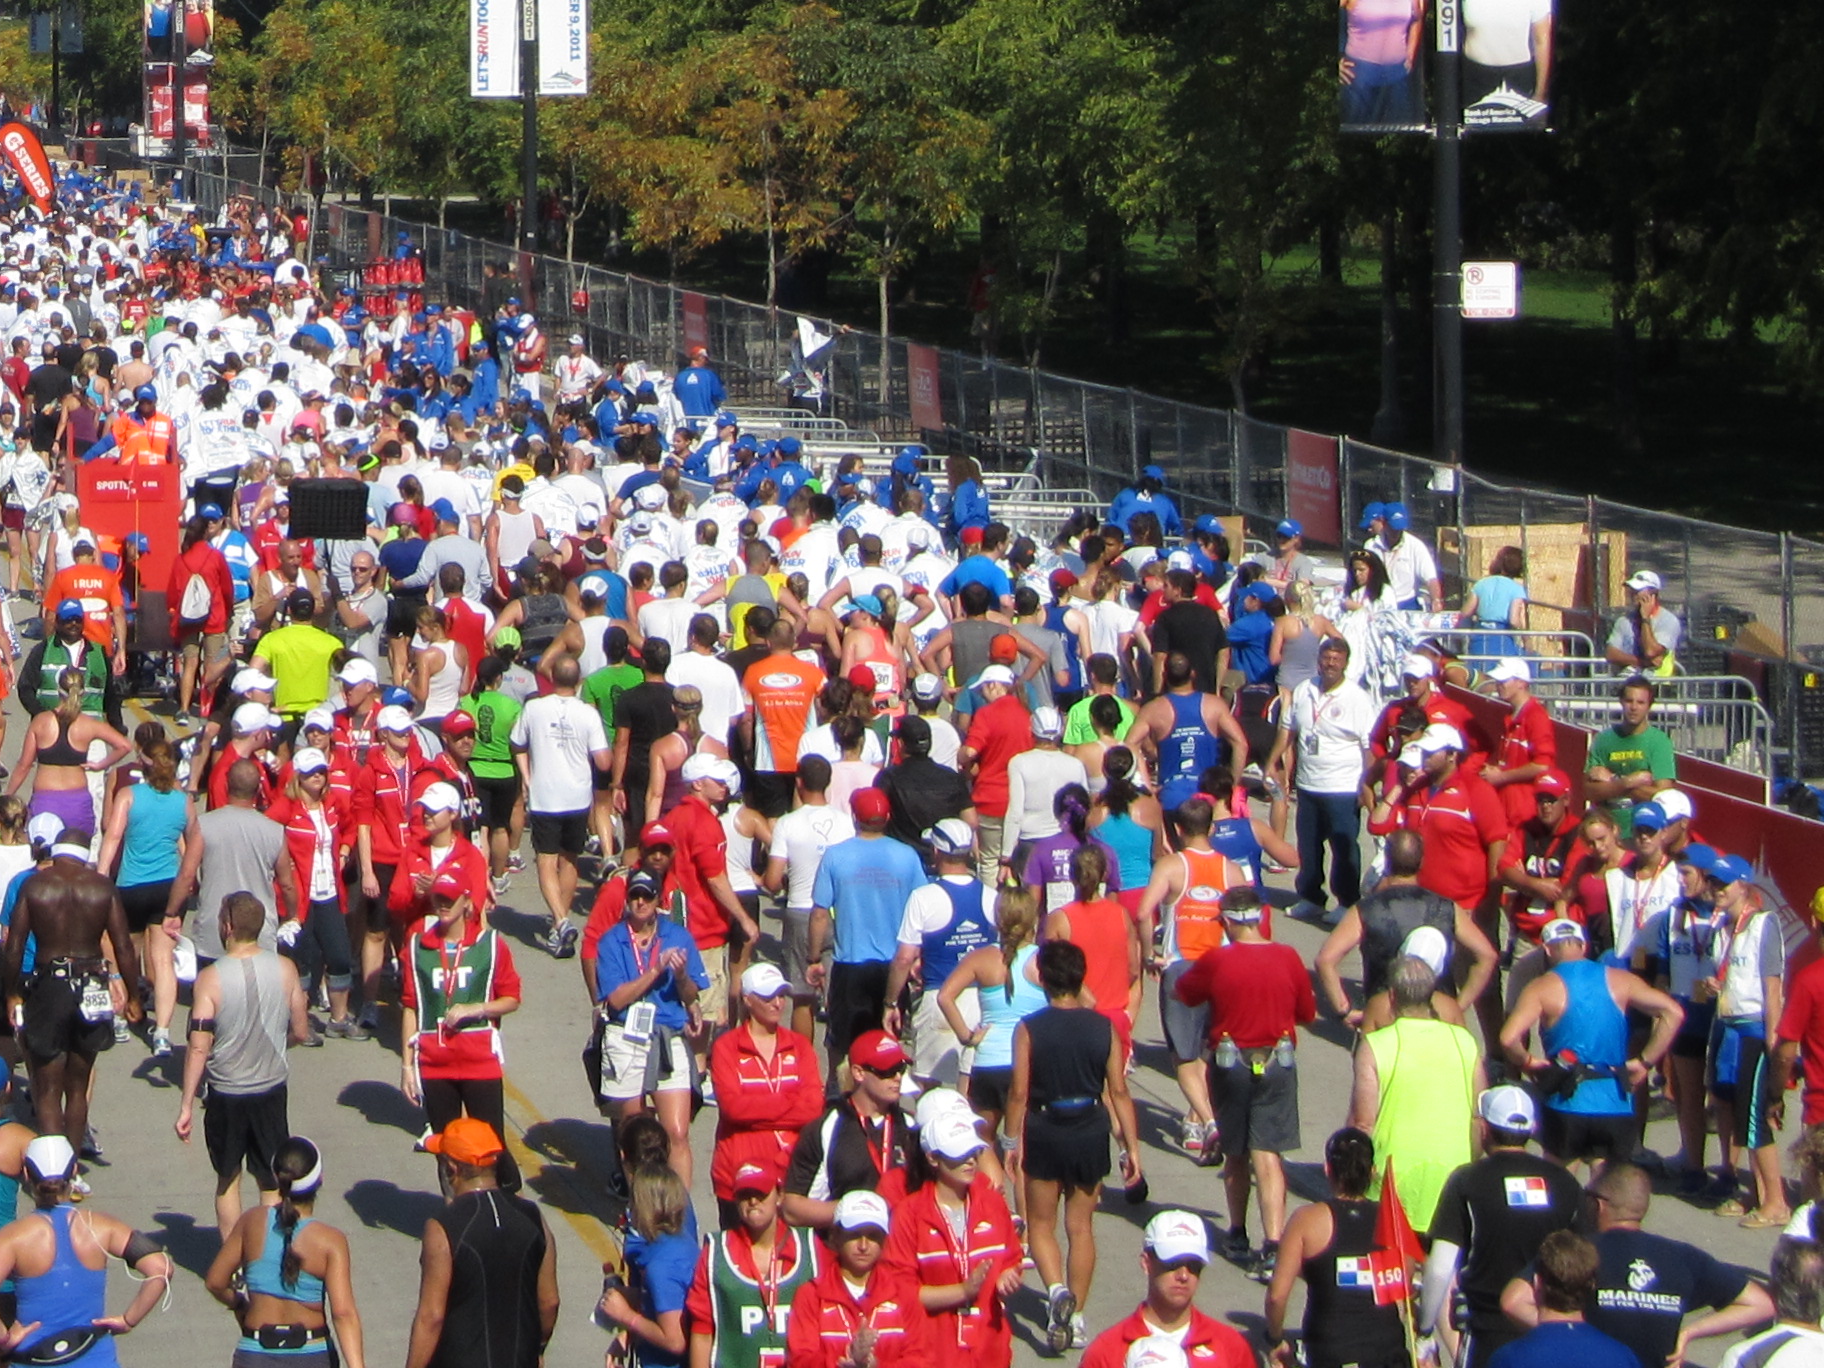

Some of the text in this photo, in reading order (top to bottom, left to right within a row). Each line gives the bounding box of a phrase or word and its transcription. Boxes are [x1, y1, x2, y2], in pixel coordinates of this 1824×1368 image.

[16, 149, 50, 199] SERIES
[79, 578, 103, 589] RUN
[432, 966, 473, 990] PT
[1377, 1266, 1403, 1287] 150
[1597, 1288, 1682, 1306] MARINES
[741, 1304, 791, 1334] PT
